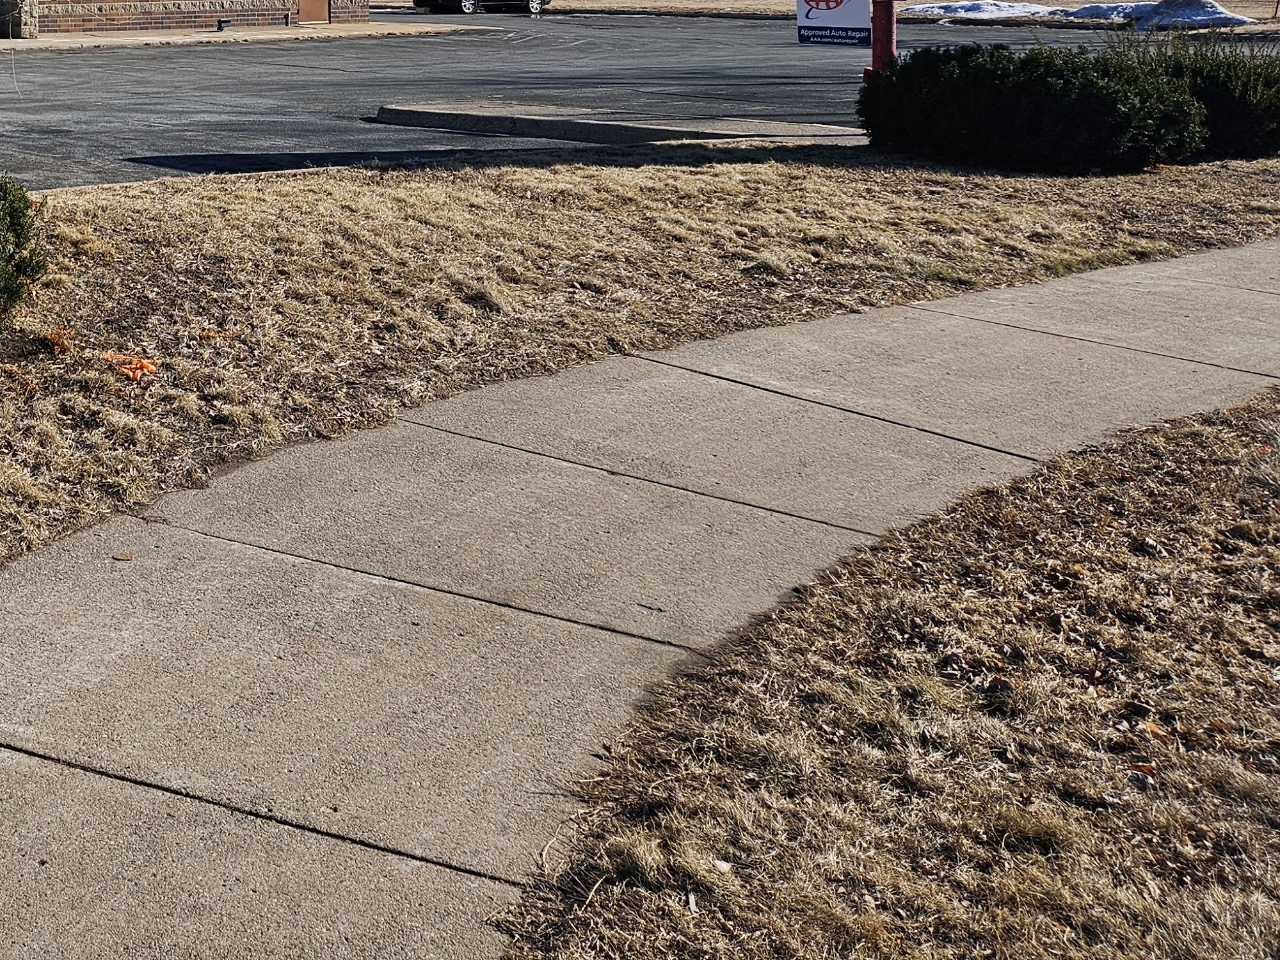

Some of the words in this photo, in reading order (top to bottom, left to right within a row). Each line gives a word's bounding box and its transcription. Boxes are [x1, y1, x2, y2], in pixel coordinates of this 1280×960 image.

[800, 28, 830, 37] Approved
[831, 29, 846, 37] Auto
[847, 30, 869, 38] Repair
